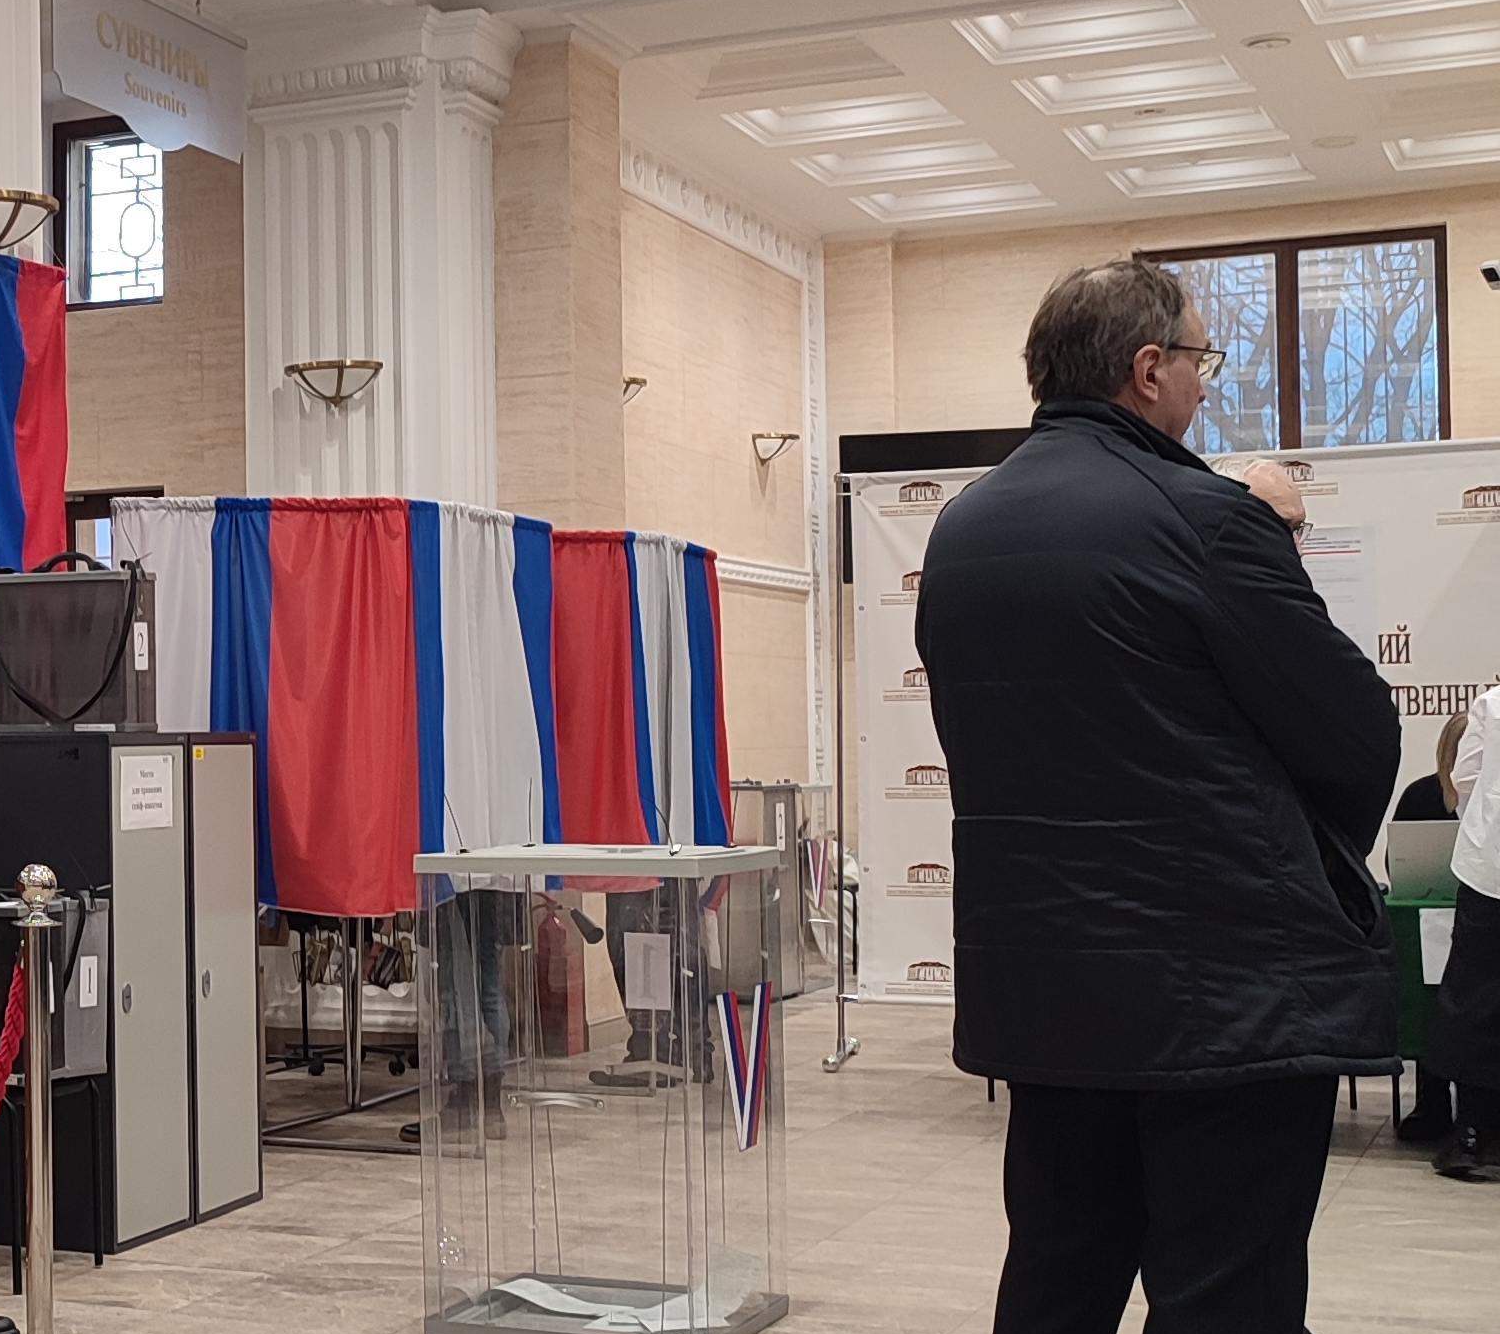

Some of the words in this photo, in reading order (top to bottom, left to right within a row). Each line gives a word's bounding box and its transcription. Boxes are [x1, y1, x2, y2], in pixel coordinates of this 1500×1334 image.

[97, 11, 211, 91] СУВЕНИРЫ
[124, 72, 187, 117] Souvenirs
[137, 632, 144, 657] 2
